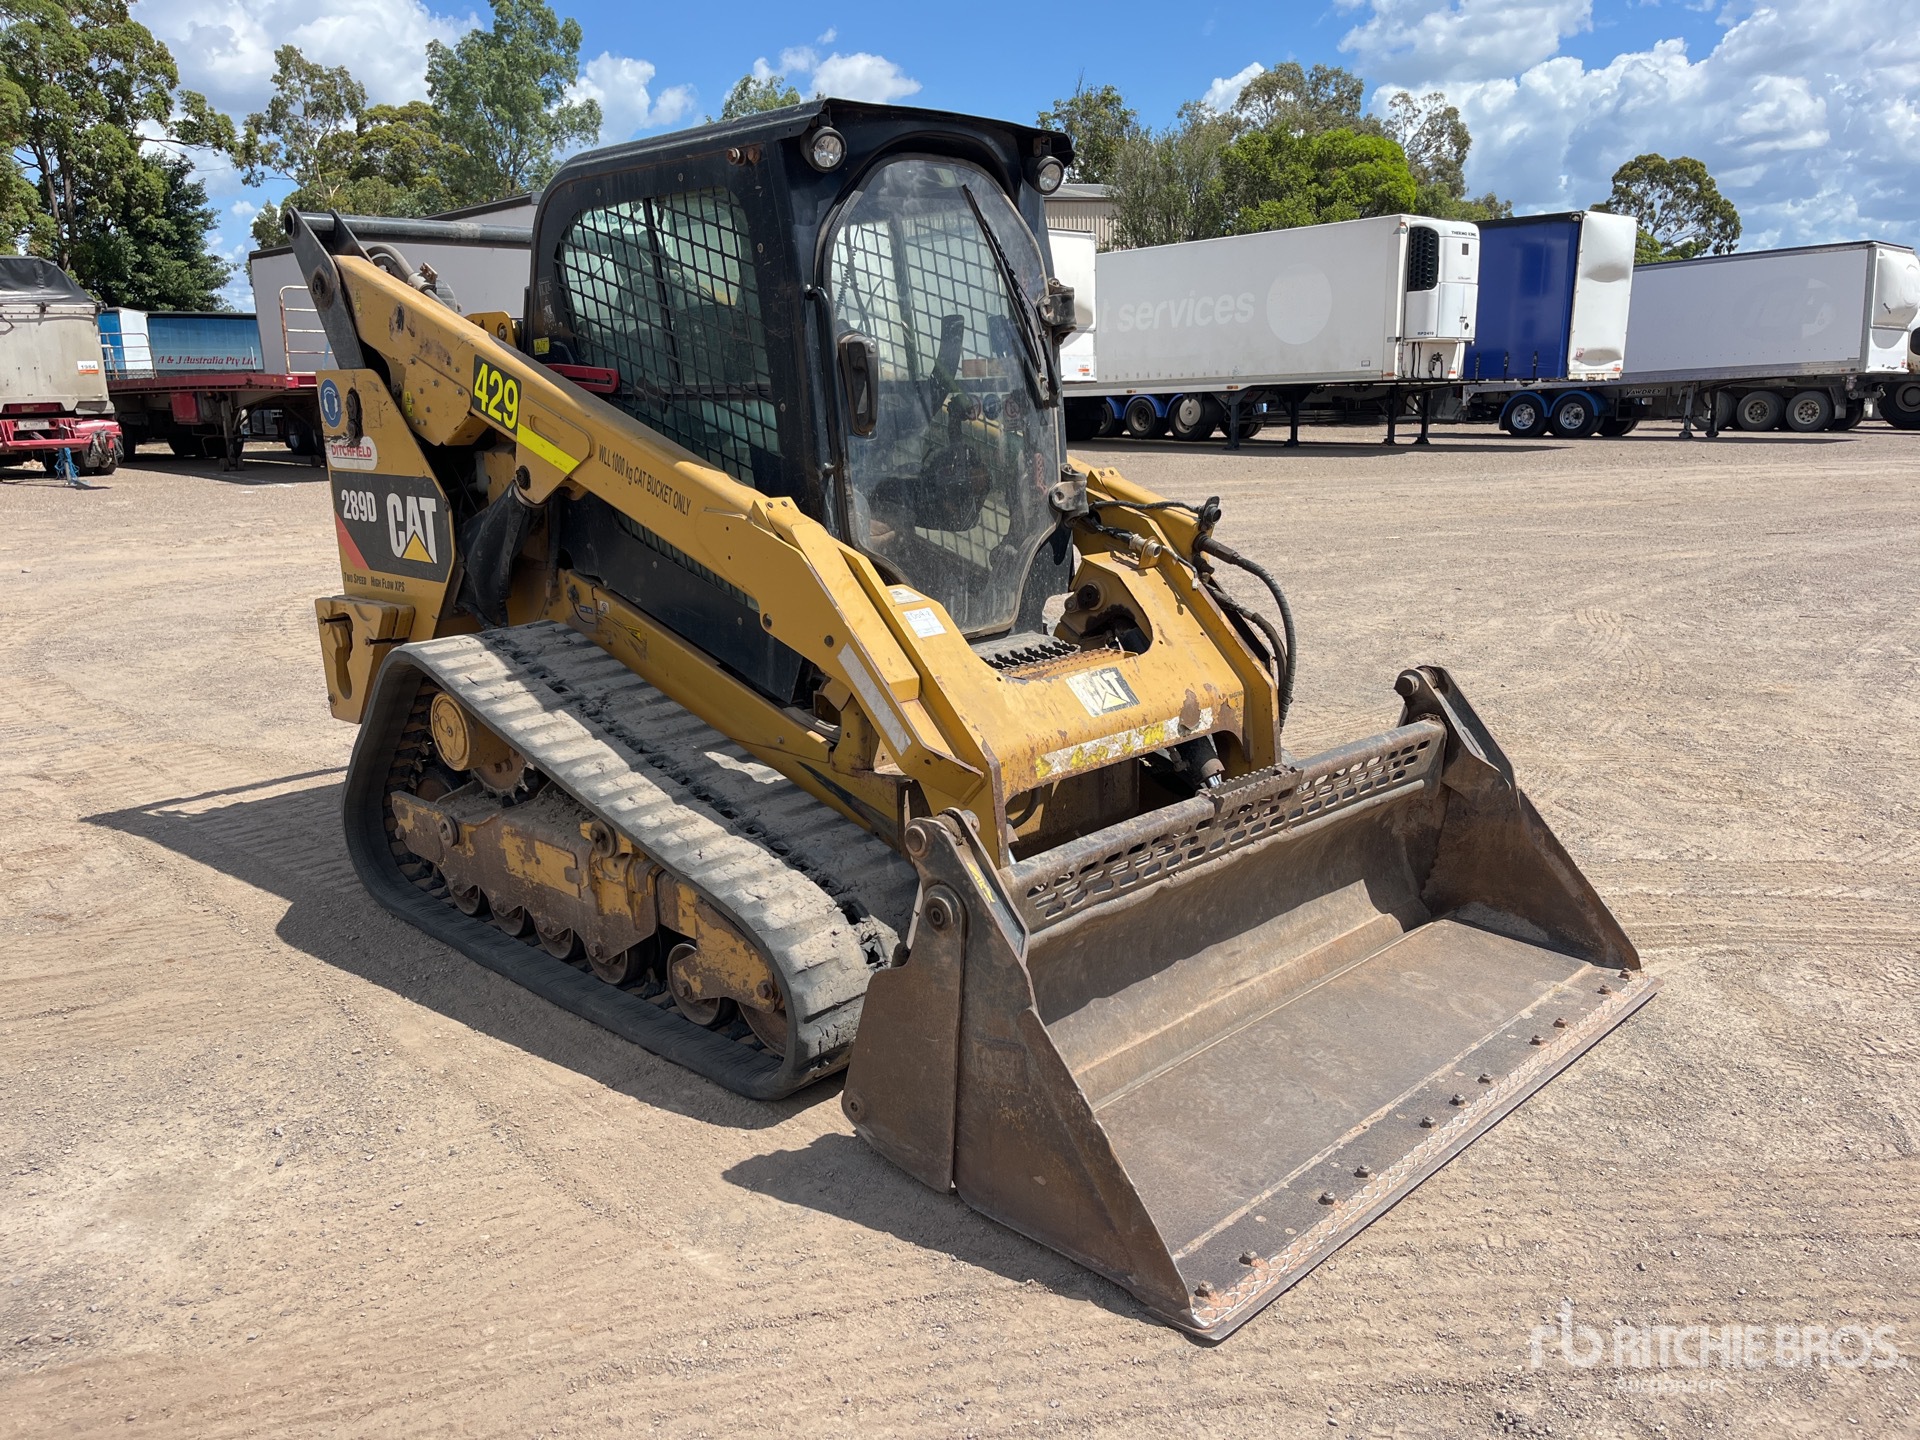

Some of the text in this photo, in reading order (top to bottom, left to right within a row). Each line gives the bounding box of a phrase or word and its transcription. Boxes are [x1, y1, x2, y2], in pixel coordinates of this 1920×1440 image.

[1117, 289, 1256, 332] services
[157, 355, 165, 363] A
[176, 356, 182, 364] J
[183, 355, 224, 365] Australia
[226, 356, 240, 367] Pty
[474, 363, 519, 430] 429
[1626, 387, 1663, 397] VAWDREY
[331, 444, 372, 458] DITCHFIELD
[599, 444, 692, 516] WLL 1000 kg CAT BUCKET ONLY
[341, 489, 438, 564] 289D CAT
[395, 580, 405, 592] XPS
